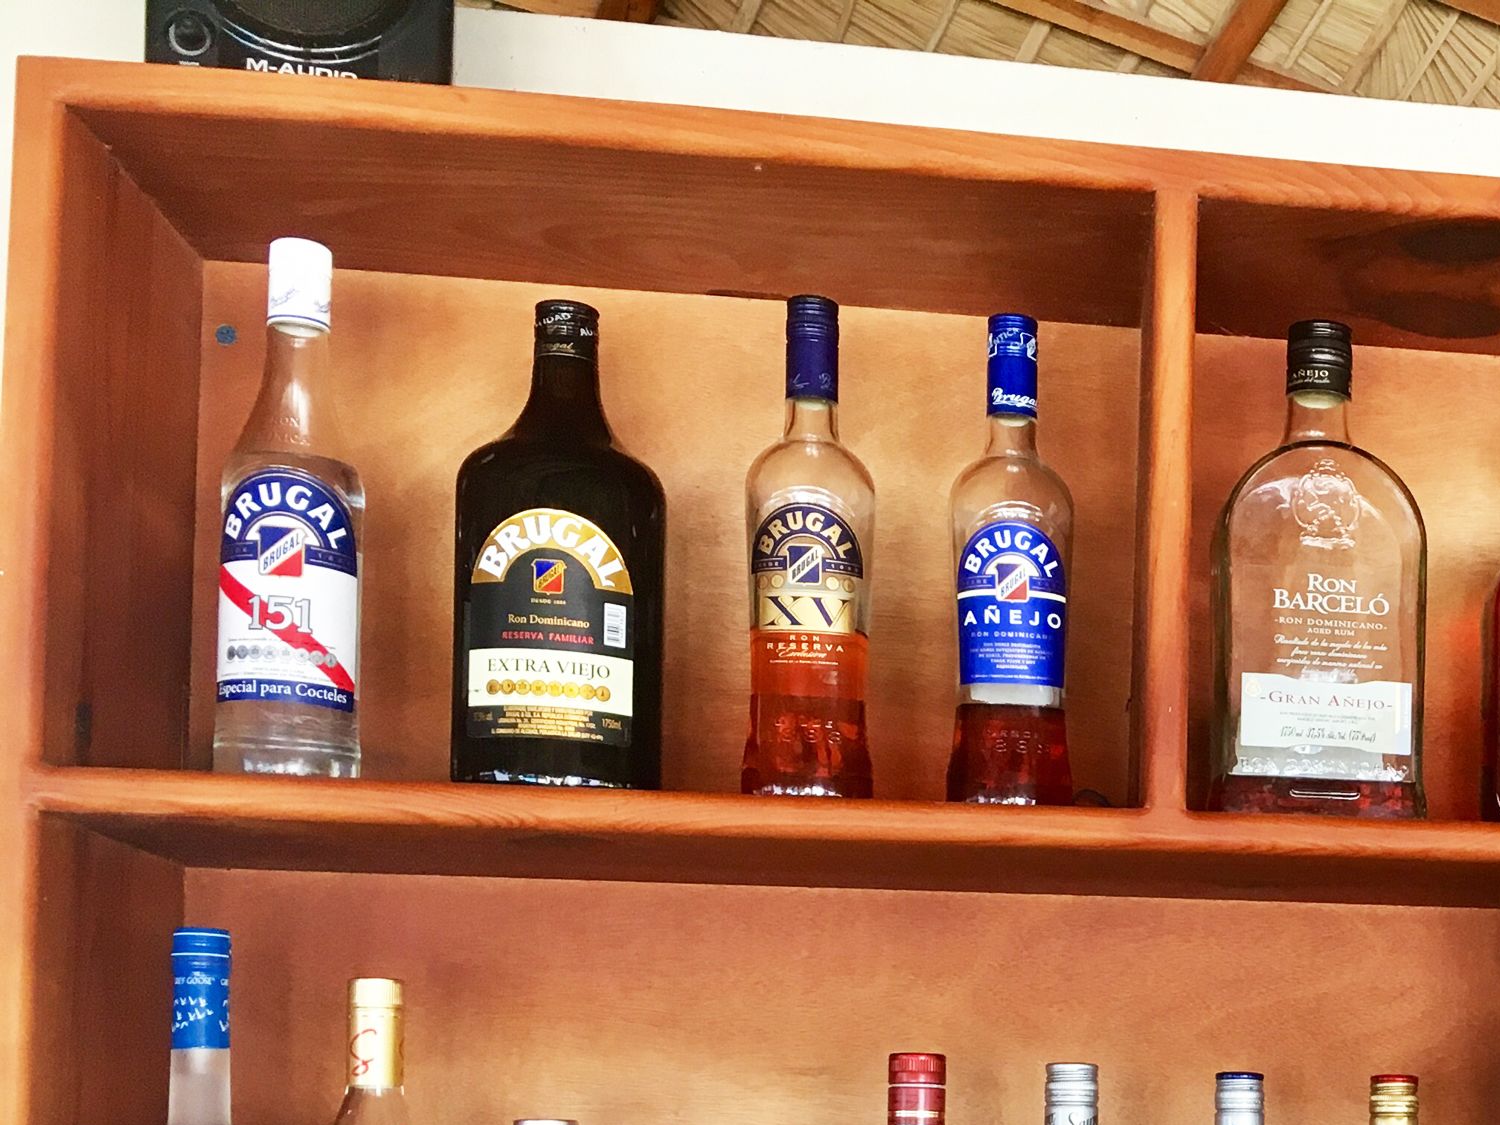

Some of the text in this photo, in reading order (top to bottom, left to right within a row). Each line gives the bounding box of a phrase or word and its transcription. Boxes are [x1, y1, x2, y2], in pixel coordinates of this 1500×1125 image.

[225, 482, 347, 549] BRUGAL
[760, 511, 852, 559] BRUGAL
[262, 536, 301, 572] BRUGAL
[479, 513, 625, 588] BRUGAL
[792, 549, 820, 580] BRUGAL
[964, 526, 1059, 578] BRUGAL
[1306, 573, 1357, 594] RON
[248, 595, 313, 634] 151
[762, 595, 850, 628] XV
[1272, 588, 1390, 616] BARCELÓ
[508, 613, 590, 629] Ron Dominicano
[964, 605, 1062, 629] AÑEJO
[502, 631, 595, 645] RESERVA FAMILIAR
[767, 642, 844, 653] RESERVA
[790, 634, 820, 642] RON
[487, 658, 611, 680] EXTRA VIEJO
[260, 683, 292, 699] para
[295, 683, 347, 705] Cocteles
